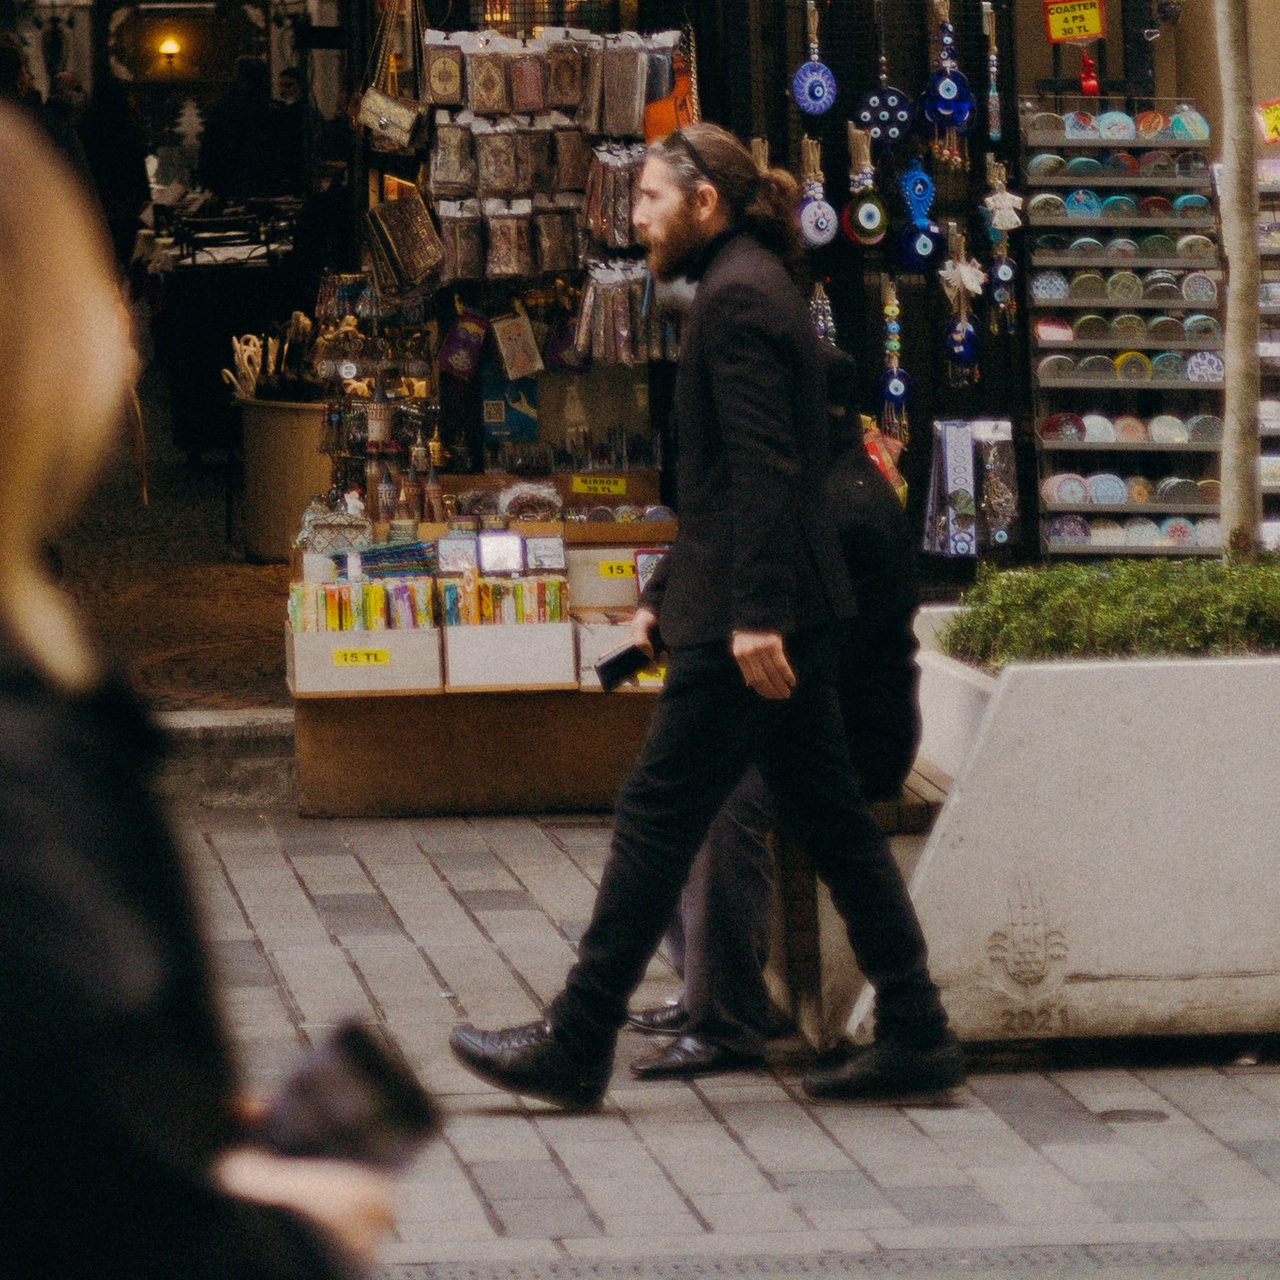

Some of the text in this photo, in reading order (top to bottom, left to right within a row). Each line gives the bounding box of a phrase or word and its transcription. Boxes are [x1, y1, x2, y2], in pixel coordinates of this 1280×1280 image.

[1049, 2, 1097, 16] COASTER
[1072, 15, 1085, 23] PS
[1061, 26, 1090, 36] 30 TL
[607, 565, 625, 575] 15
[342, 652, 382, 662] 15 TL
[1000, 1008, 1069, 1034] 2021
